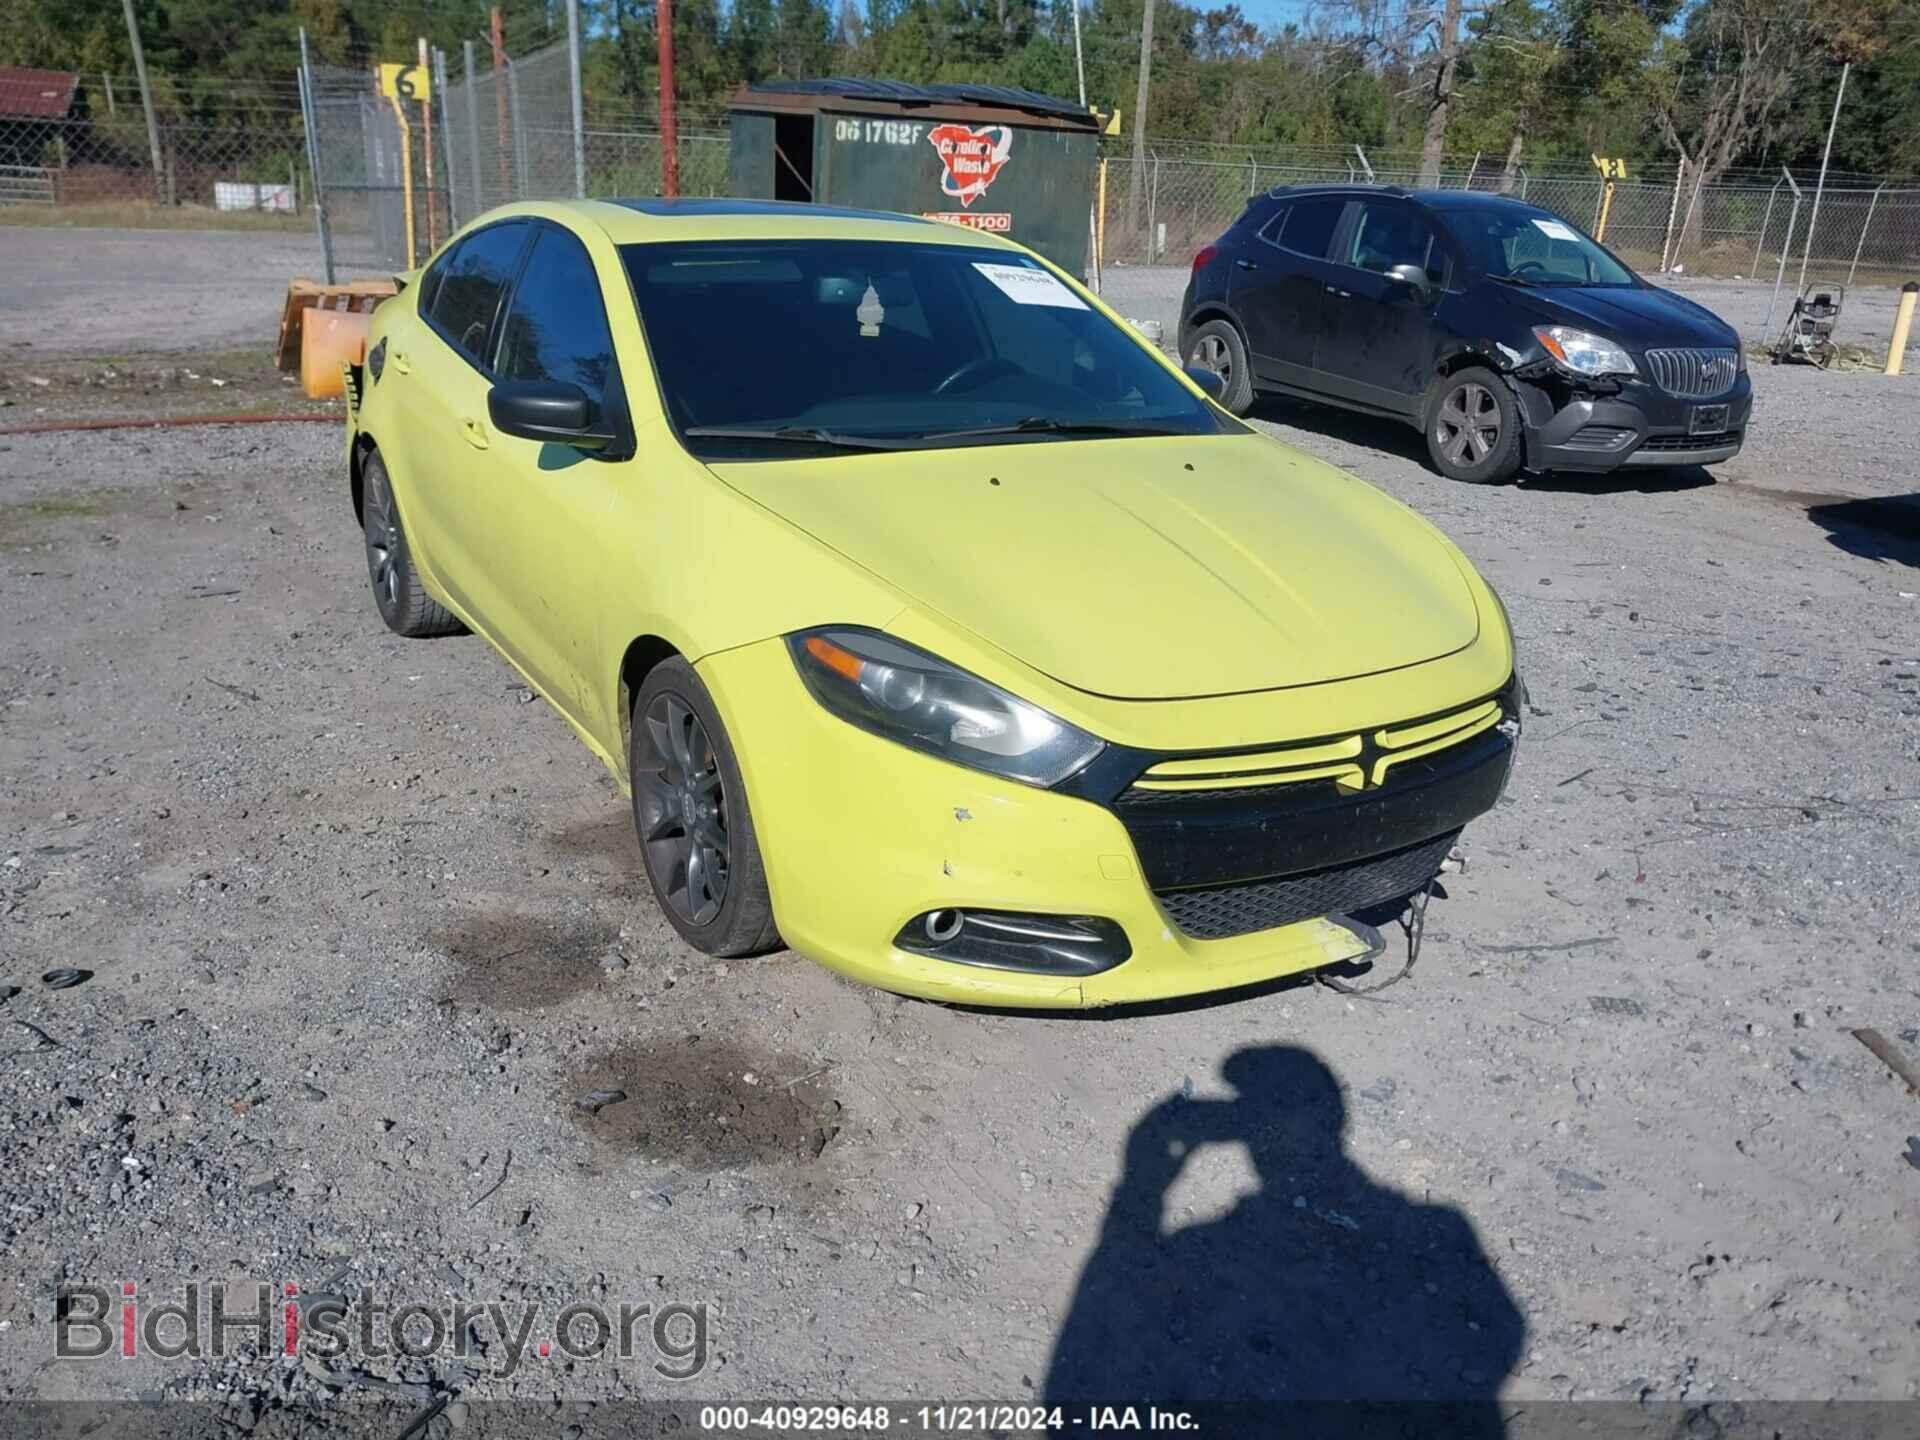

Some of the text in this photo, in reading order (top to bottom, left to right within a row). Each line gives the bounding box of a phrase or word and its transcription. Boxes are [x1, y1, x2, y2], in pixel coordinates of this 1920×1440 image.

[395, 64, 415, 98] 6
[941, 138, 992, 155] Carolina
[953, 157, 991, 175] Waste
